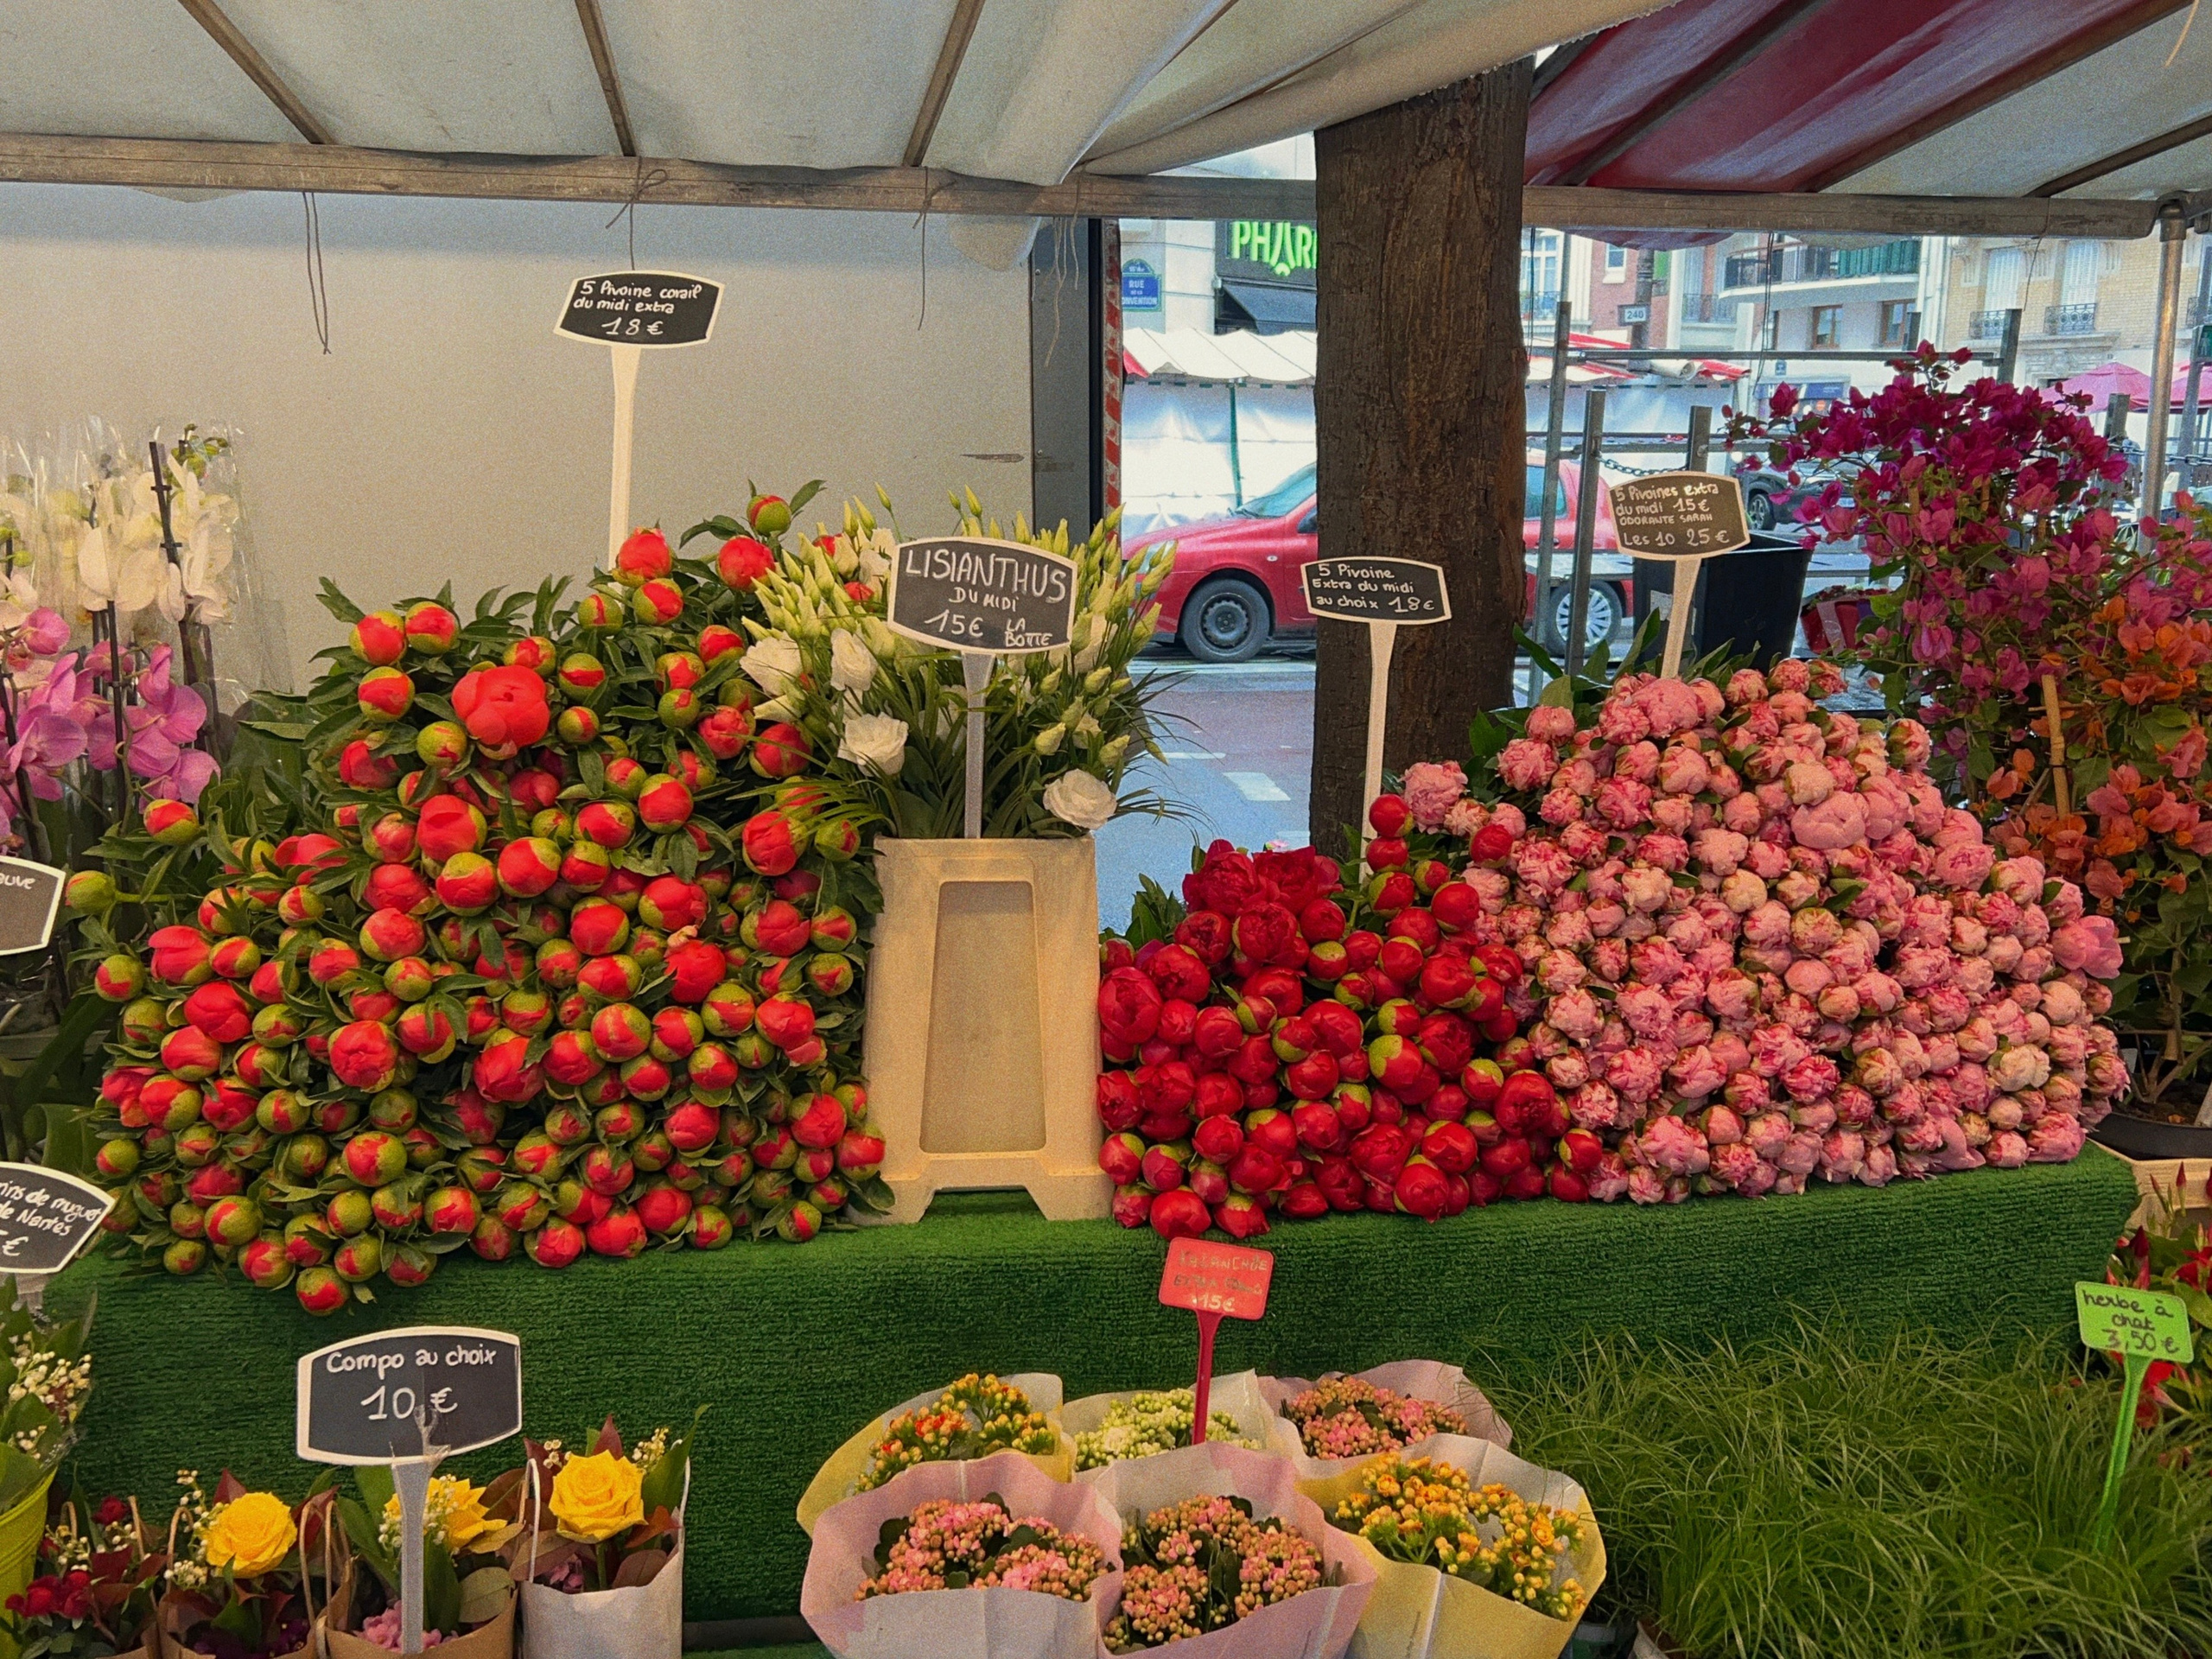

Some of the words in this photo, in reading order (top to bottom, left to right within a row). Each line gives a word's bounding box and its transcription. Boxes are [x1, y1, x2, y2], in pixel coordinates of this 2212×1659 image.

[580, 280, 597, 296] 5
[600, 279, 653, 299] Pivoine
[659, 283, 703, 300] corail
[1128, 280, 1145, 289] RUE
[573, 297, 594, 309] du
[596, 299, 630, 312] midi
[634, 302, 676, 315] extra
[1626, 309, 1644, 320] 240
[1615, 487, 1626, 502] 5
[1628, 485, 1679, 502] Pivoines
[1684, 482, 1719, 496] extra
[1616, 504, 1634, 517] du
[1635, 501, 1663, 515] midi
[1619, 515, 1675, 526] ODORANTE
[1680, 512, 1713, 524] SARAH
[1624, 531, 1651, 546] Les
[1655, 531, 1676, 547] 10
[906, 549, 1068, 604] LISIANTHUS
[1319, 563, 1332, 577] 5
[1338, 563, 1395, 579] Pivoine
[1312, 578, 1352, 590] Extra
[1357, 581, 1379, 593] du
[1382, 581, 1414, 594] midi
[948, 587, 978, 604] DU
[1315, 595, 1333, 606] au
[1337, 595, 1379, 610] choix
[1006, 618, 1027, 632] LA
[1005, 631, 1054, 647] BOTTE
[25, 1187, 51, 1208] de
[50, 1197, 103, 1223] muguet
[16, 1209, 73, 1236] Nantes
[2082, 1289, 2145, 1313] herbe
[2111, 1313, 2156, 1332] chat
[326, 1351, 405, 1381] Compo
[415, 1348, 439, 1366] au
[445, 1344, 498, 1367] choix
